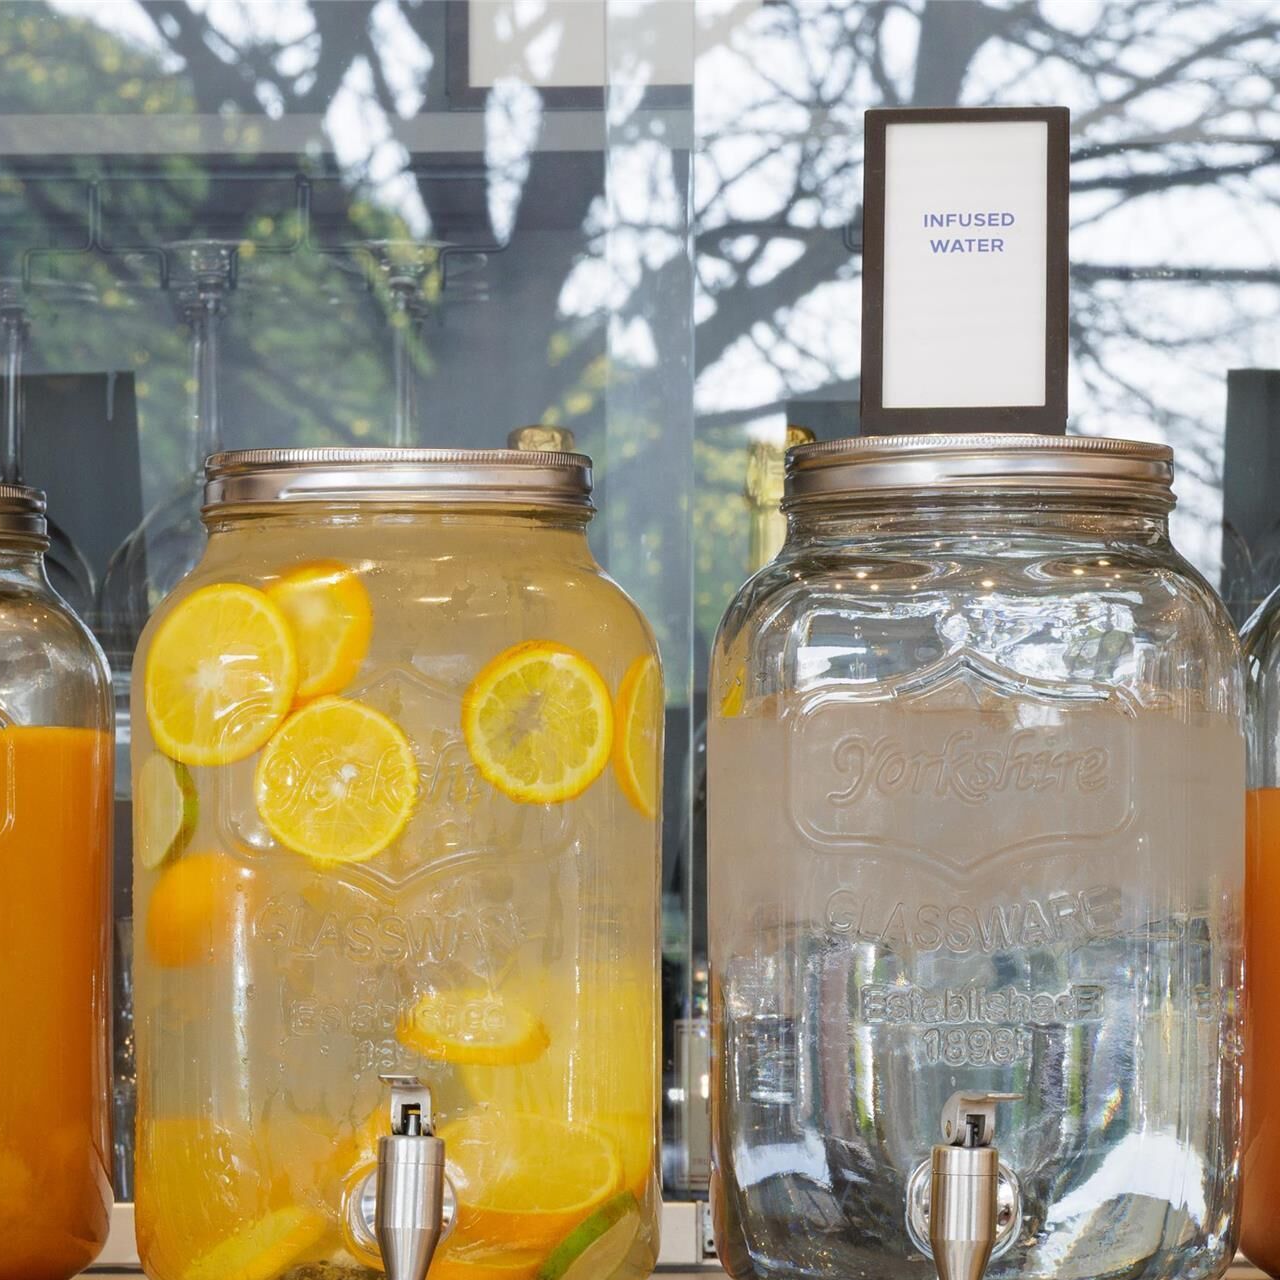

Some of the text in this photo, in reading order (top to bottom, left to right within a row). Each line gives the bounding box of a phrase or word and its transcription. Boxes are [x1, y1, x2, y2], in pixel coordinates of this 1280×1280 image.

[923, 213, 1015, 227] INFUSED
[930, 239, 1004, 253] WATER
[825, 729, 1109, 807] Yorkshire
[823, 886, 1123, 953] GLASSWARE
[859, 983, 1082, 1025] Established
[921, 1028, 1018, 1067] 1898
